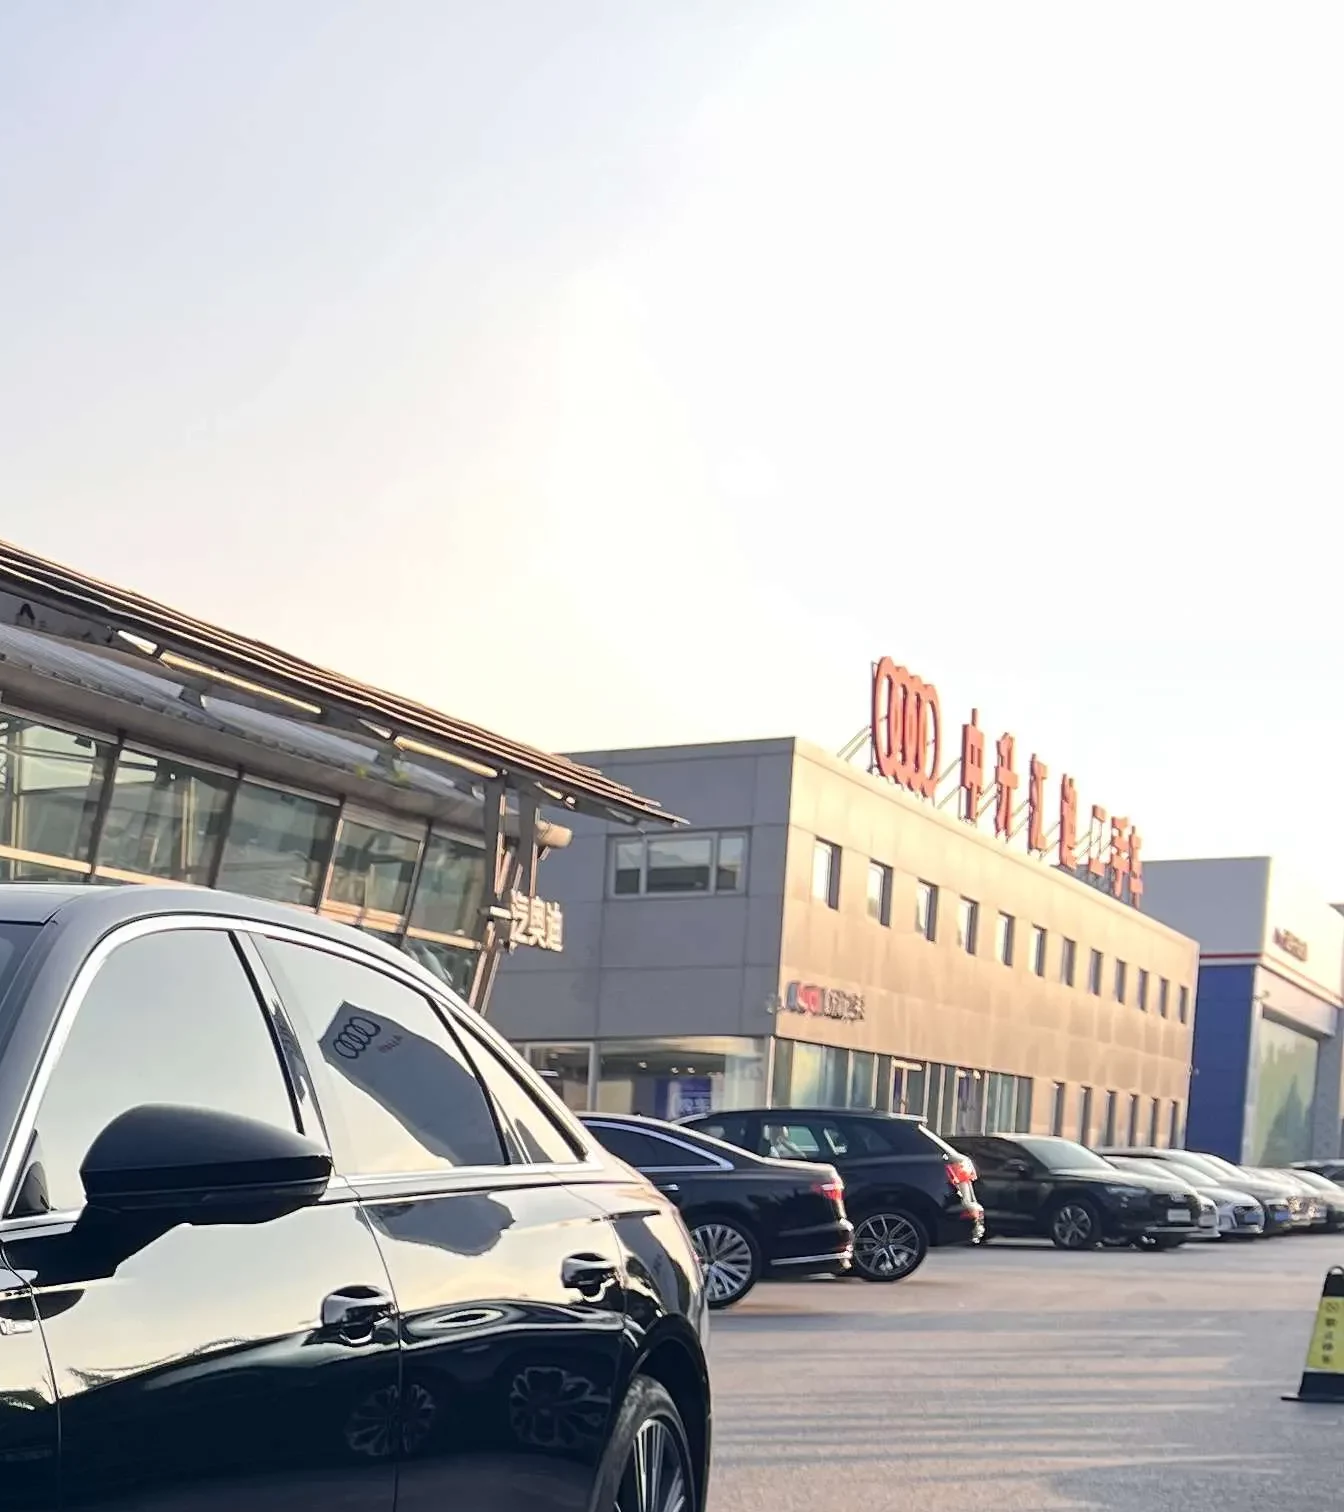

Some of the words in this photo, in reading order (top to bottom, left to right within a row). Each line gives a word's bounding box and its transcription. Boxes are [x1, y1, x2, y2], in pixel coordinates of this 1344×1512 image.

[962, 707, 1143, 911] 中升汇迪二手车
